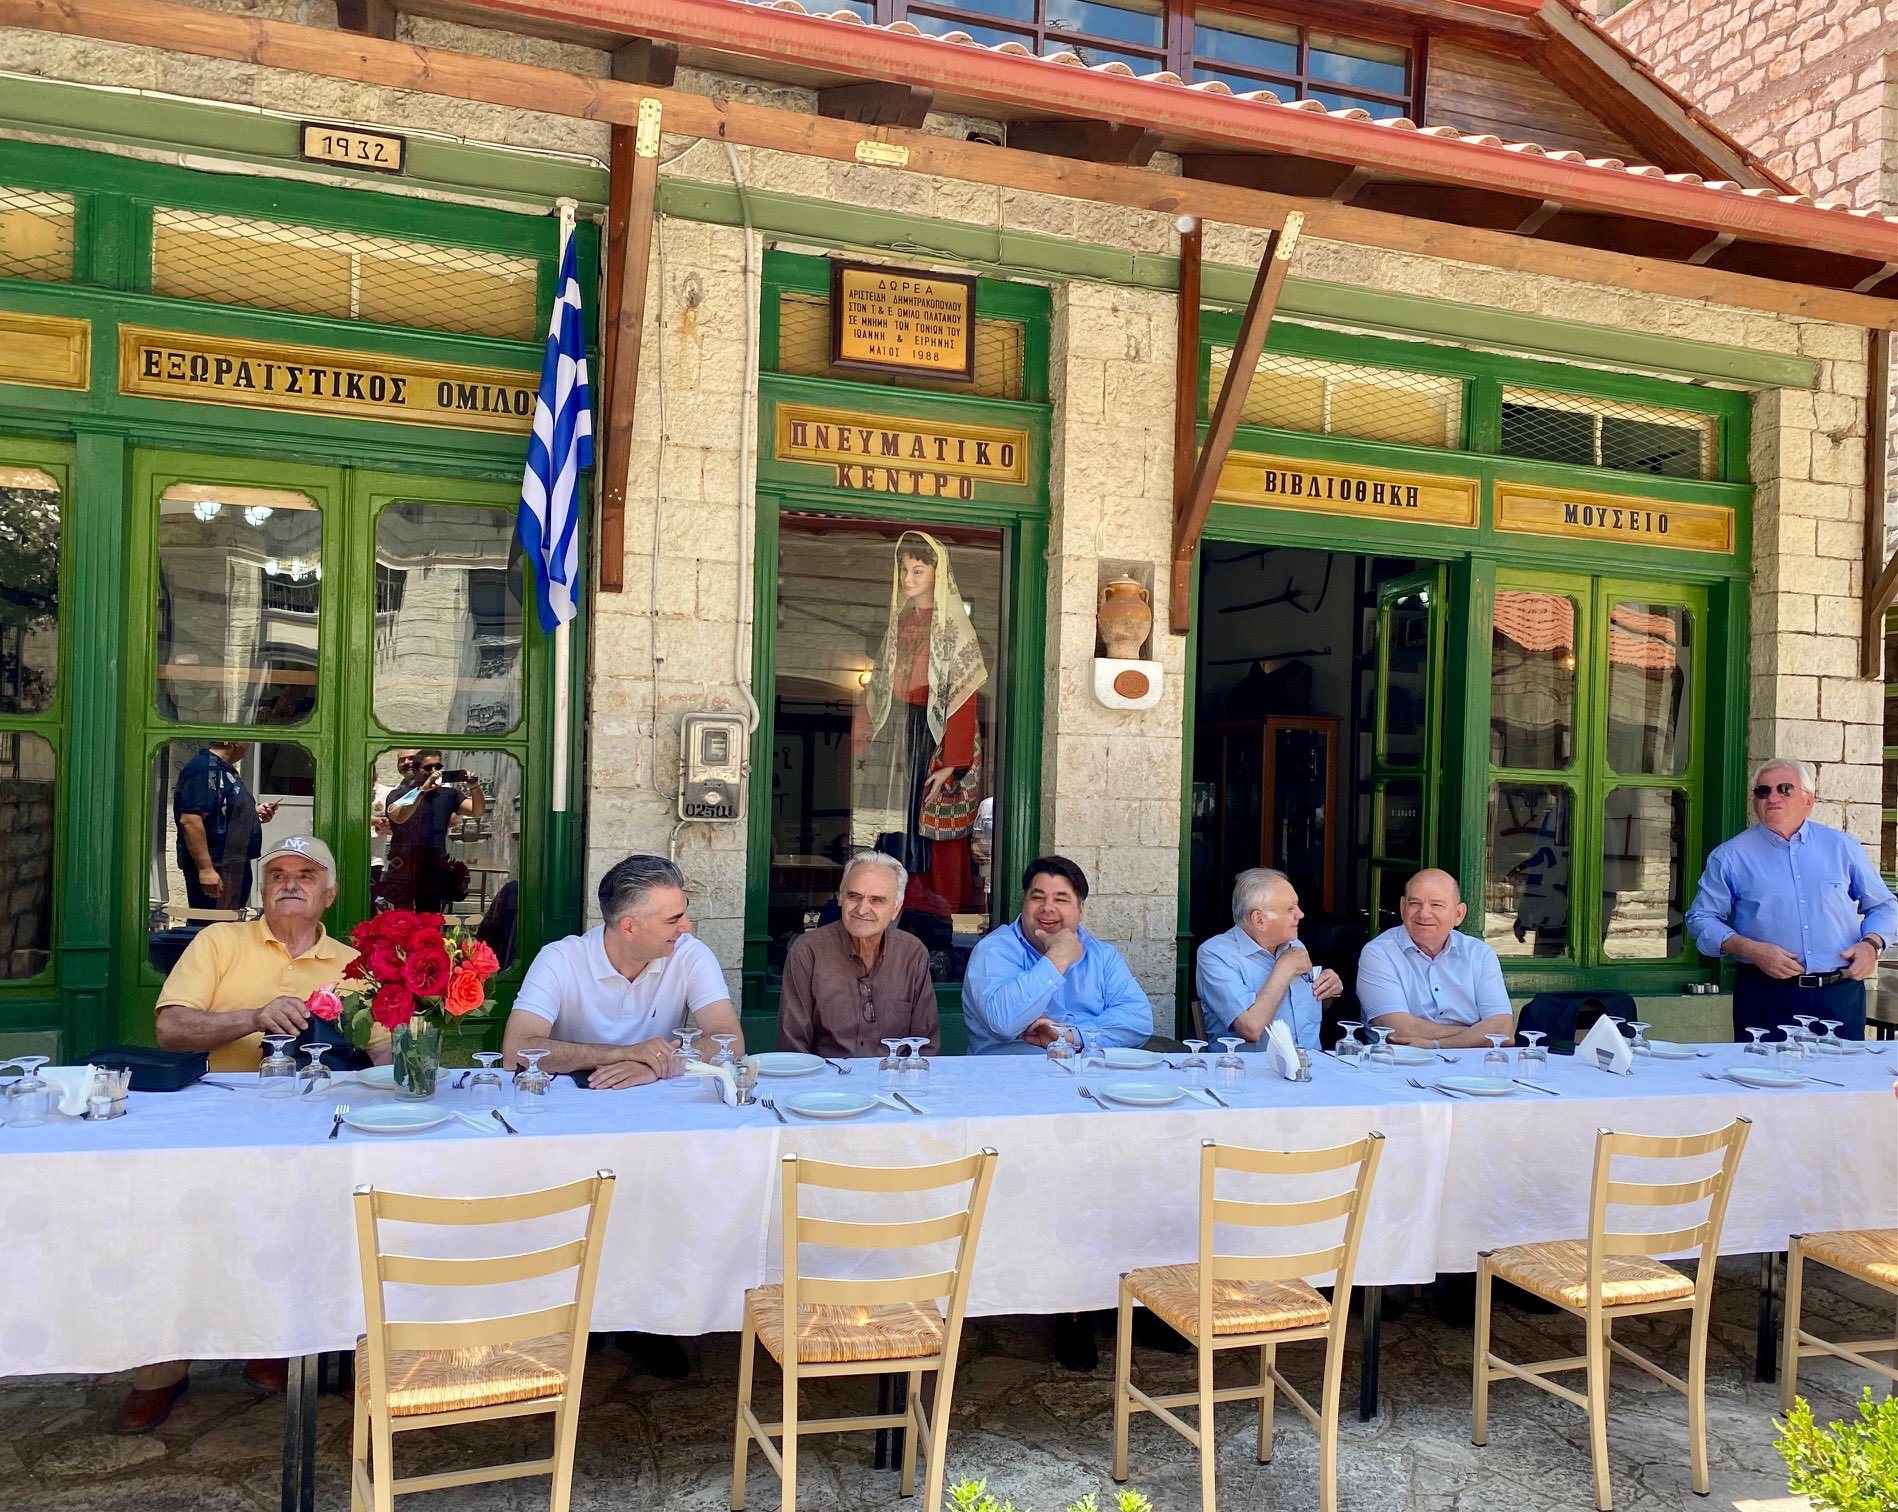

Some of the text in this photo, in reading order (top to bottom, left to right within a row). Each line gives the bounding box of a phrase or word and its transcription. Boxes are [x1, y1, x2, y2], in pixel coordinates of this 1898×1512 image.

[321, 135, 389, 162] 1932
[878, 279, 933, 295] ΔΩΡΕΑ
[848, 289, 962, 312] ΑΡΙΣΤΕΙΔΗ ΔΗΜΗΤΡΑΚΟΠΟΥΛΟΥ
[848, 301, 867, 313] ΣΤΟΝ
[871, 304, 876, 314] Τ
[878, 305, 885, 314] &
[897, 308, 920, 319] ΟΜΙΛΟ
[924, 311, 961, 324] ΠΛΑΤΑΝΟΥ
[848, 314, 961, 337] ΣΕ ΜΝΗΜΗ ΤΩΝ ΓΟΝΙΩΝ ΤΟΥ
[853, 328, 955, 349] ΙΩΑΝΝΗ & ΕΙΡΗΝΗΣ
[912, 349, 940, 361] 1988
[791, 422, 1014, 467] ΠΝΕΥΜΑΤΙΚΟ
[838, 464, 972, 500] ΚΕΝΤΡΟ
[1264, 470, 1419, 507] ΒΙΒΛΙΟΘΗΚΗ
[1564, 503, 1668, 534] ΜΟΥΣΕΙΟ
[281, 836, 310, 853] NY
